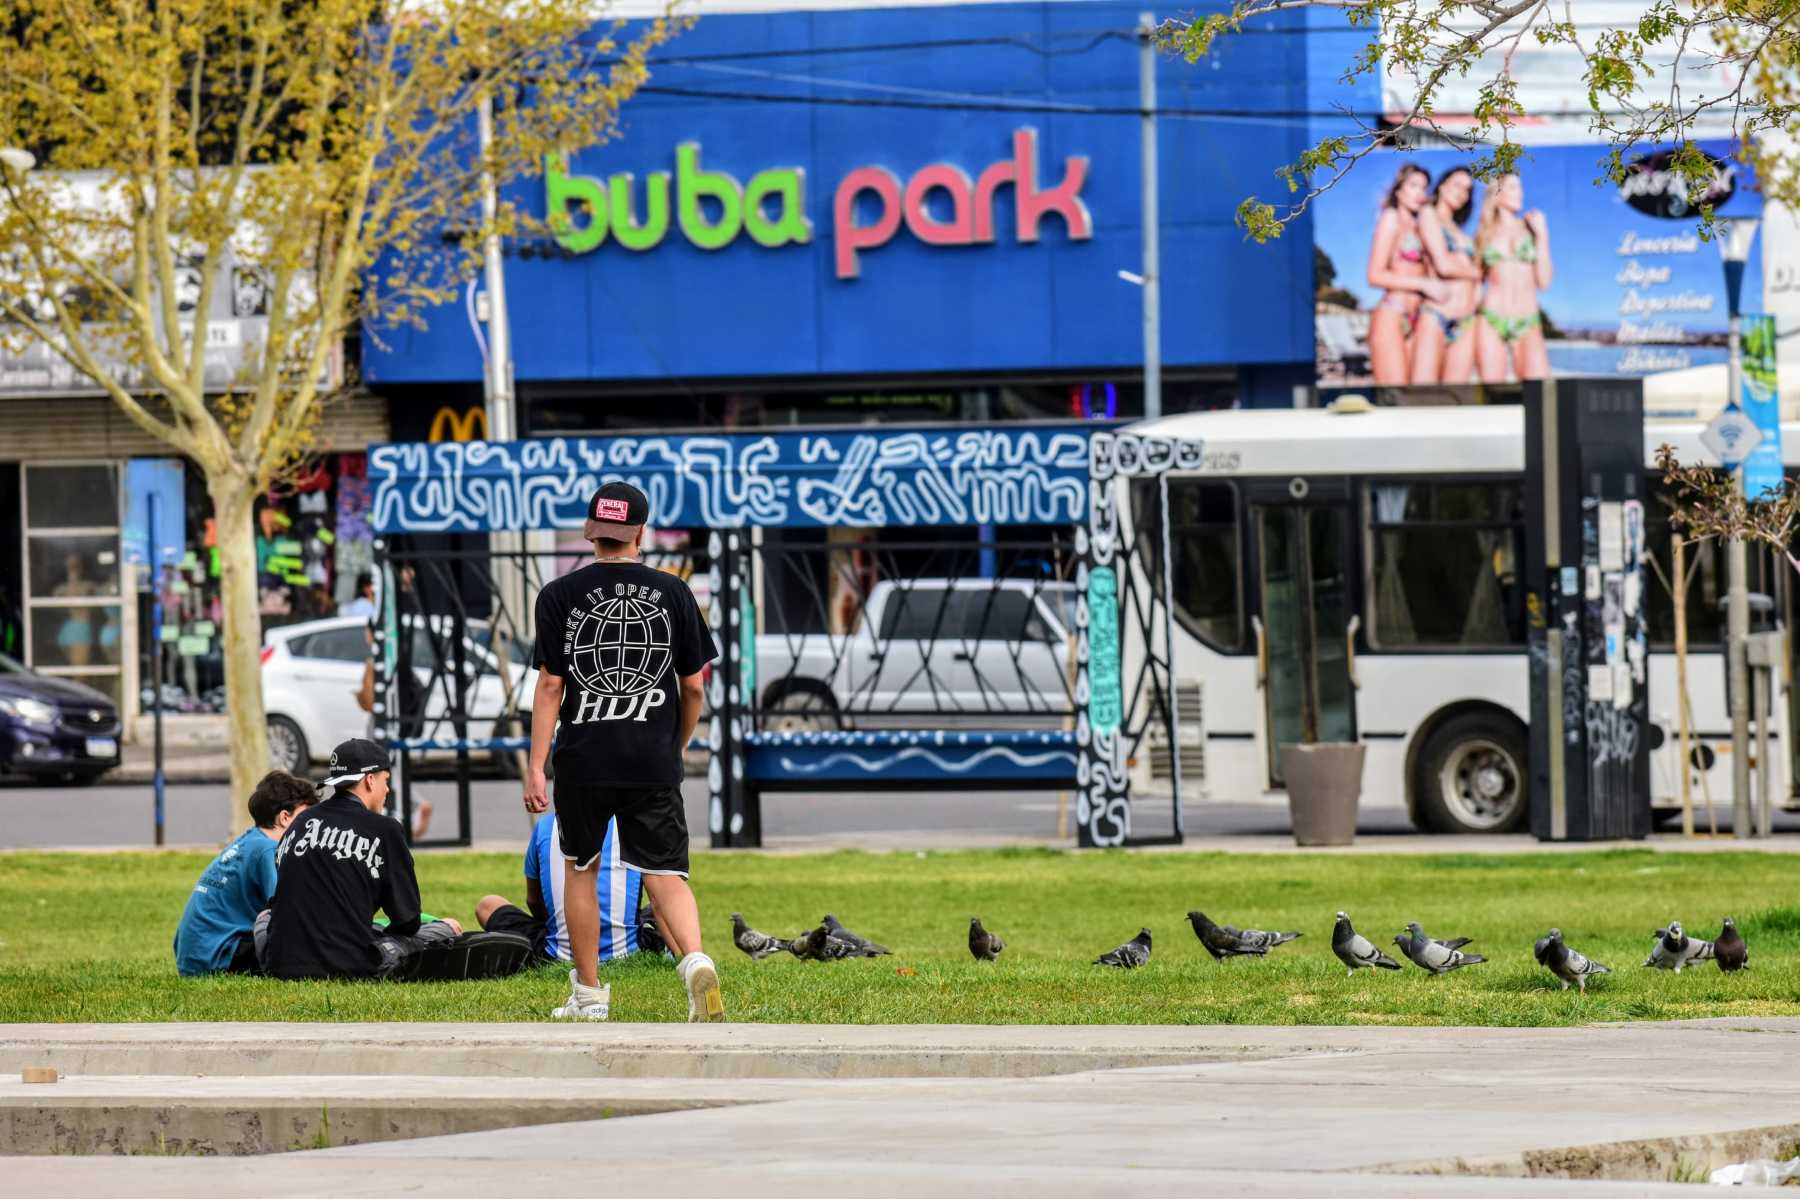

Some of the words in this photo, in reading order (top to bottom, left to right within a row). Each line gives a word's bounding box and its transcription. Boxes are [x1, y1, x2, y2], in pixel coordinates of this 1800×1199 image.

[546, 142, 812, 254] buba
[834, 127, 1093, 280] park
[586, 587, 605, 605] IT
[615, 583, 662, 604] OPEN
[571, 688, 666, 725] HDP
